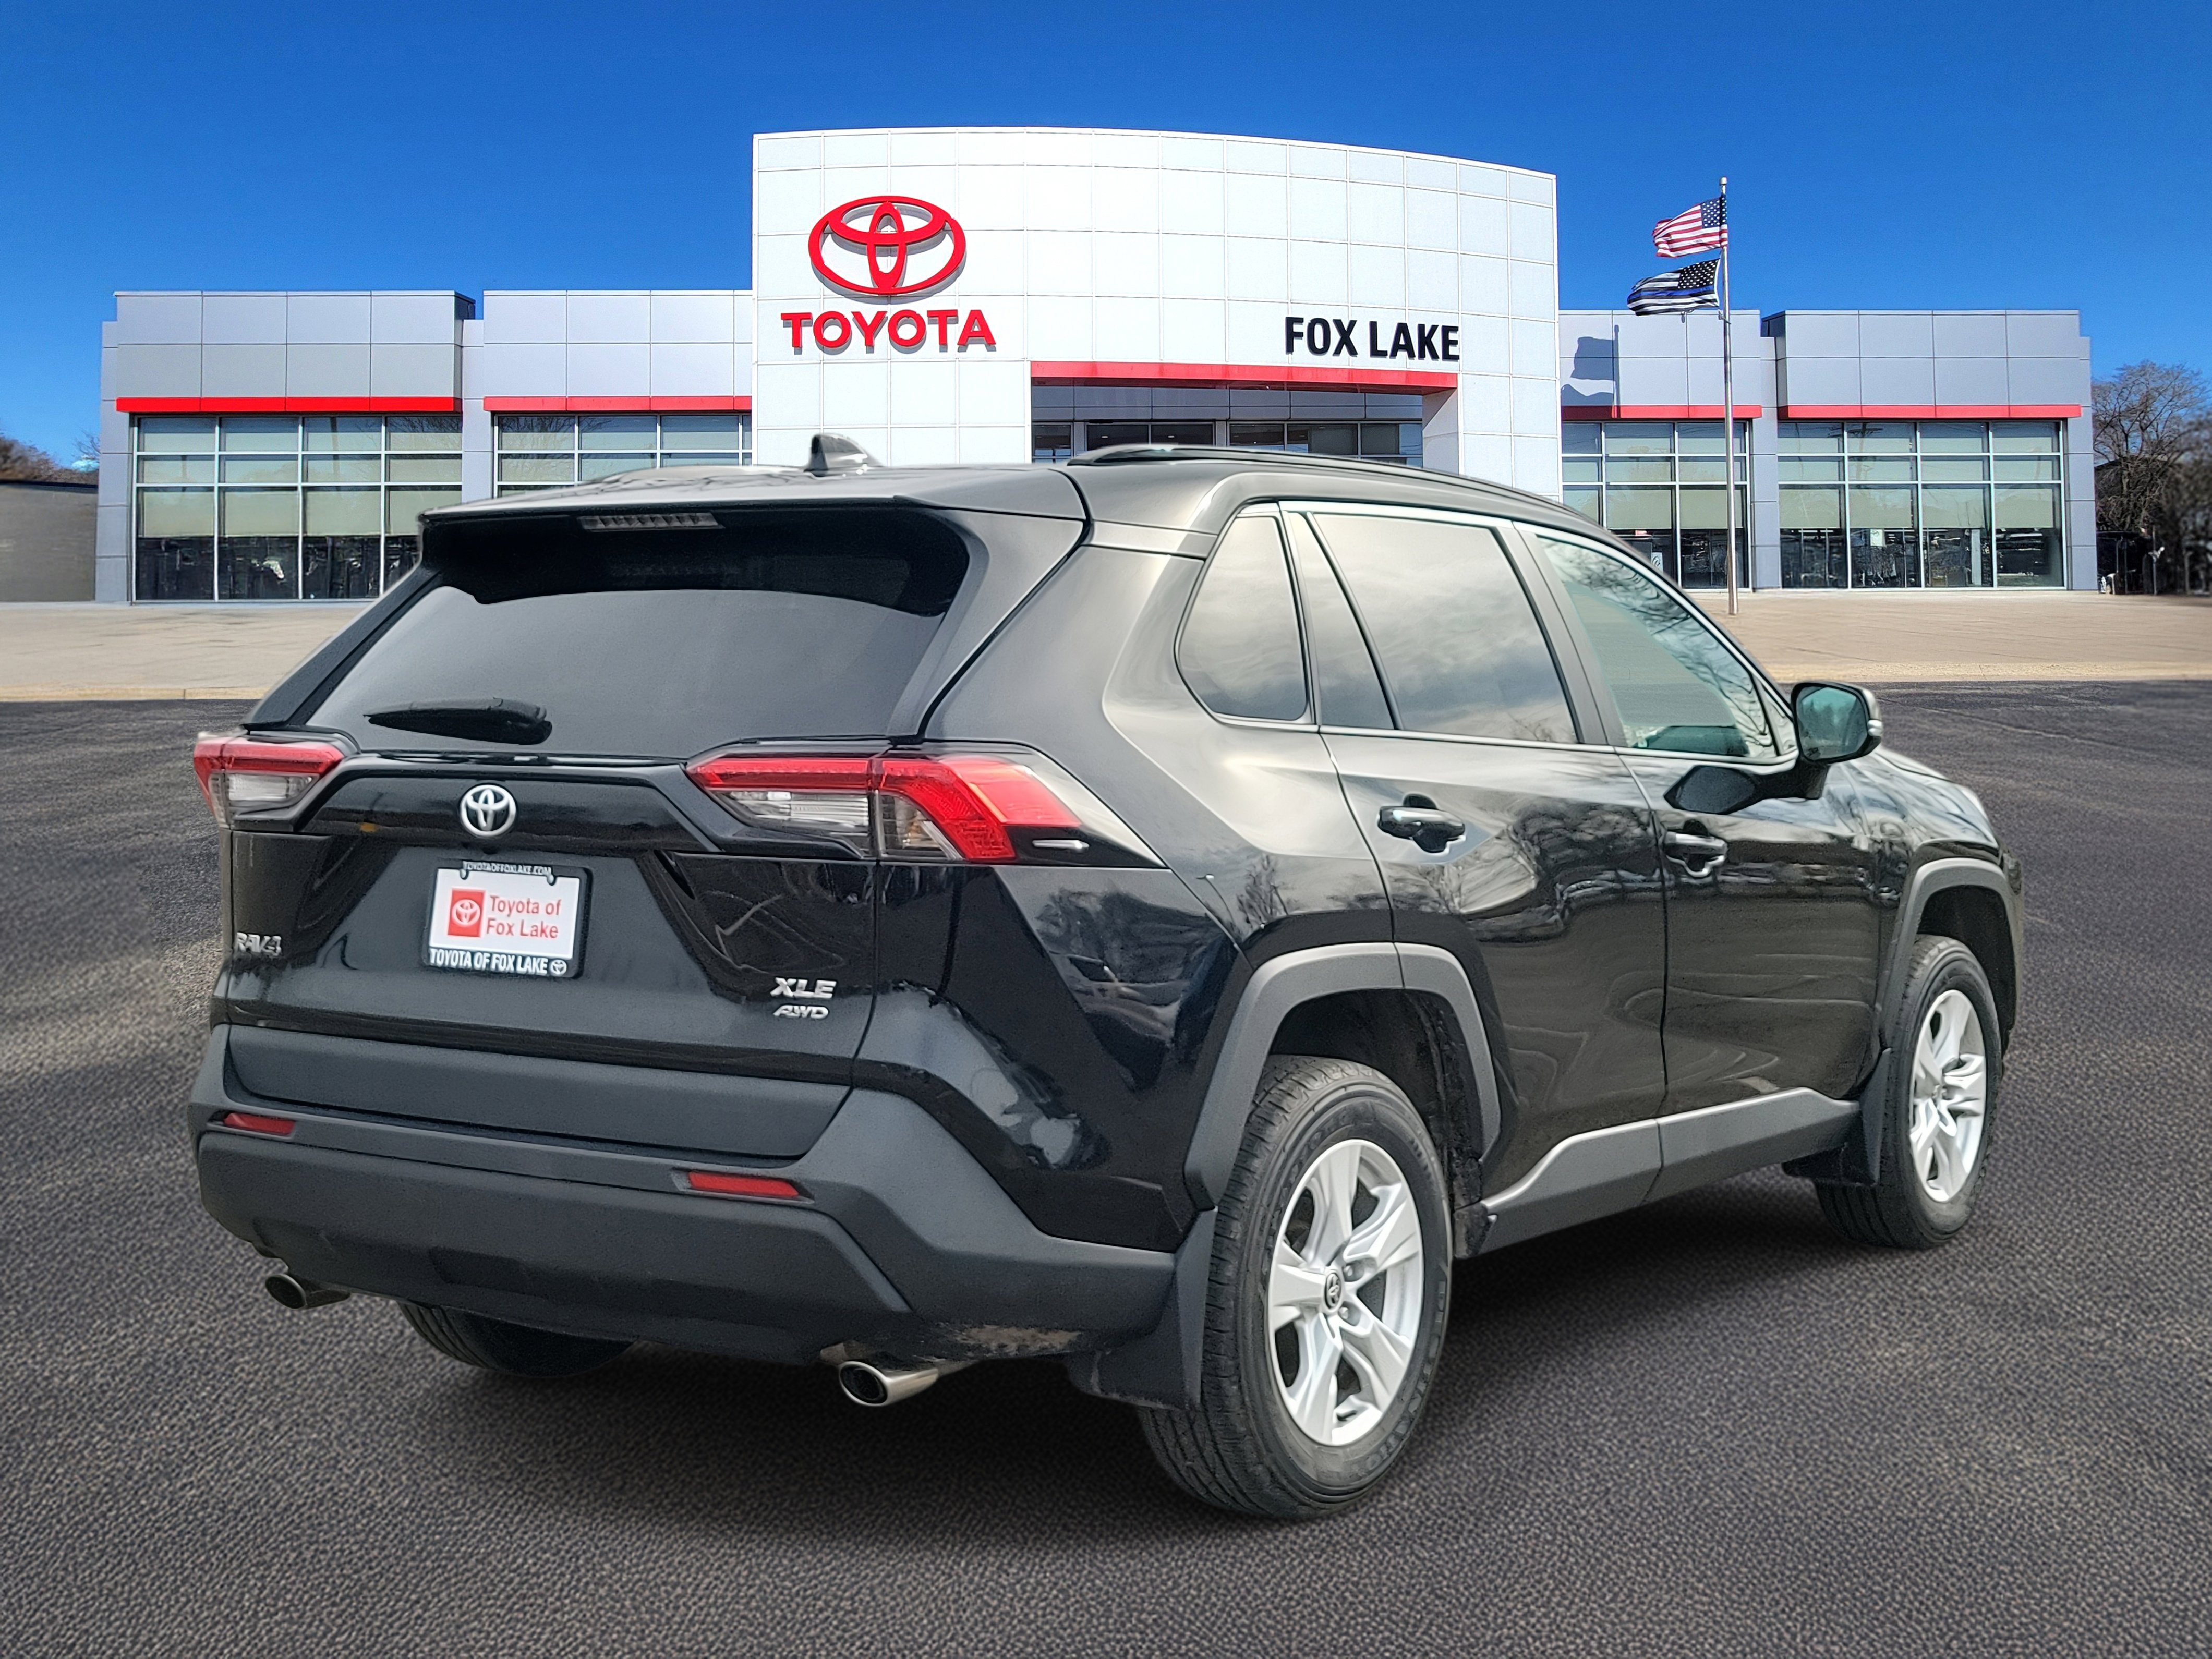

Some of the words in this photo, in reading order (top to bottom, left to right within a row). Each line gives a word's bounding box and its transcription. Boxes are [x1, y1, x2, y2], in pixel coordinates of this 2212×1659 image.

[781, 310, 996, 353] TOYOTA
[1285, 316, 1358, 357] FOX
[1369, 321, 1460, 361] LAKE
[490, 895, 540, 917] Toyota
[545, 899, 562, 915] of
[486, 917, 514, 936] Fox
[519, 919, 559, 939] Lake
[430, 948, 472, 968] TOYOTA
[474, 952, 490, 970] OF
[490, 953, 514, 973] FOX
[516, 955, 548, 976] LAKE
[770, 977, 837, 999] XLE
[773, 1004, 829, 1019] AWD
